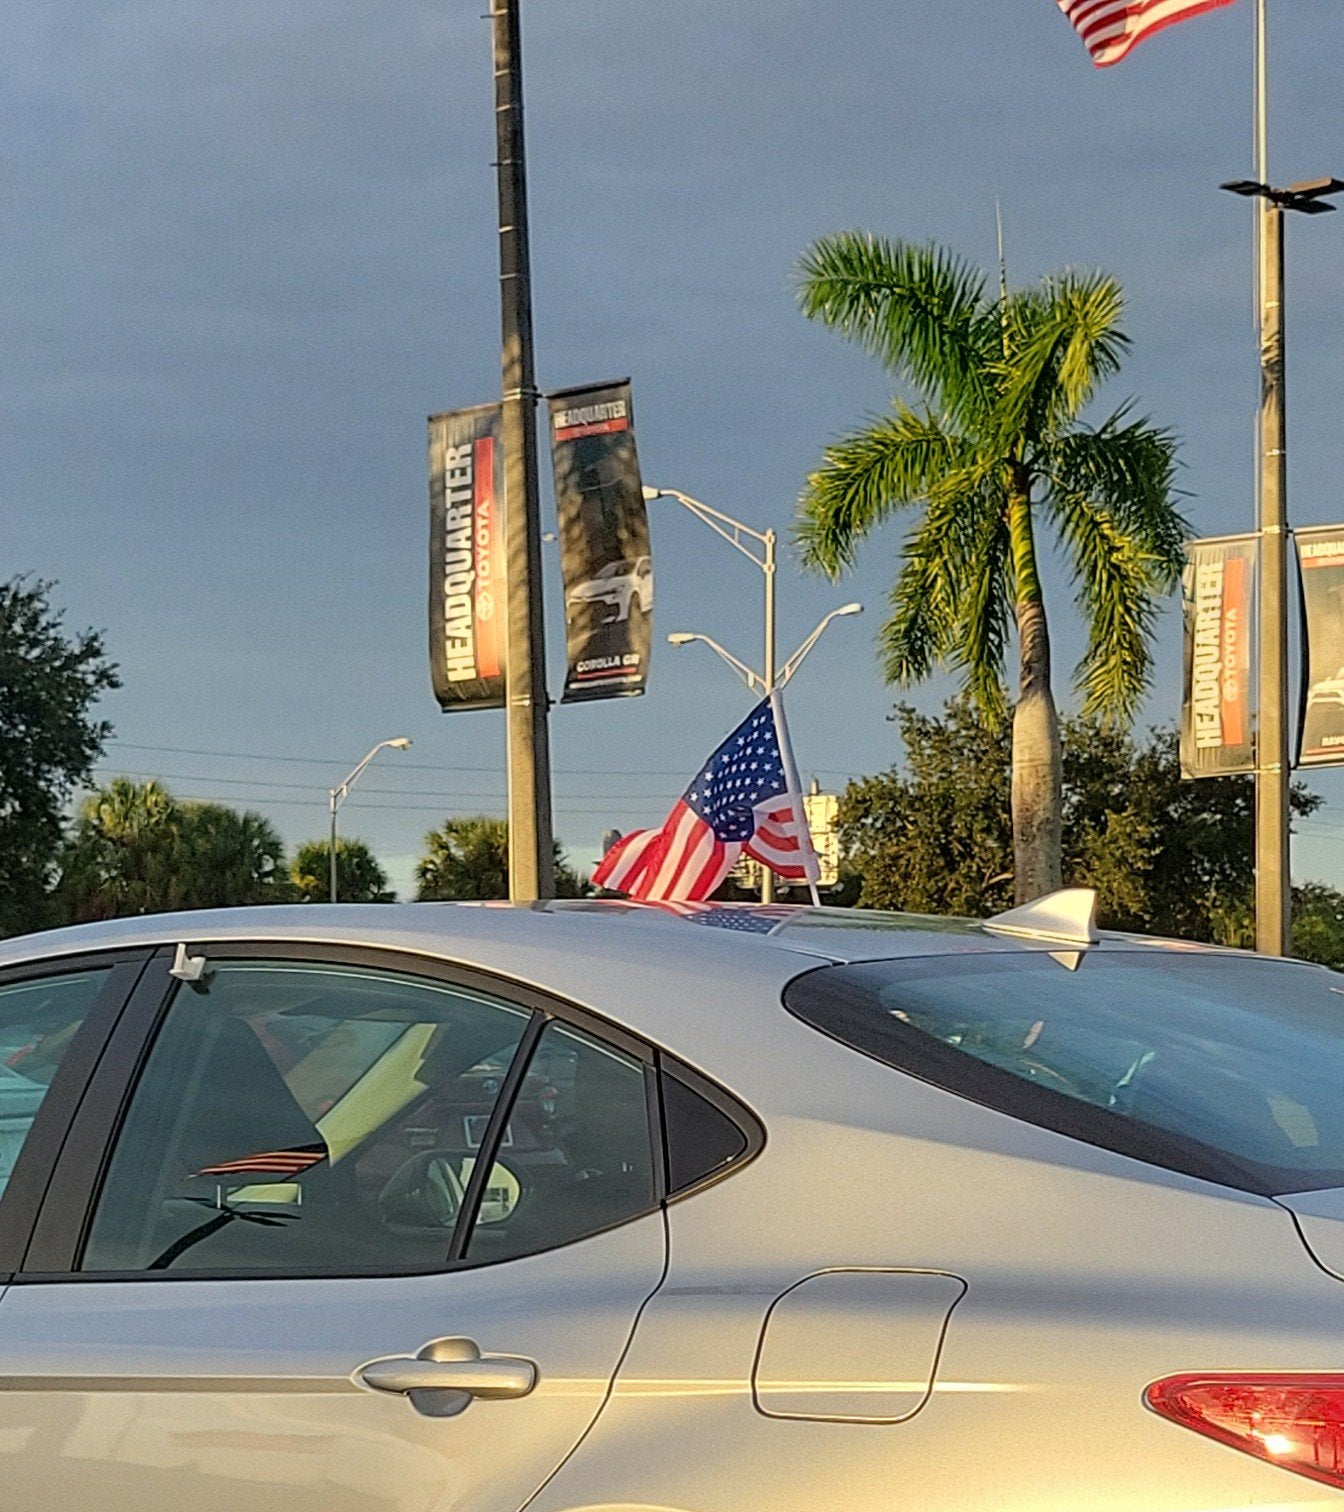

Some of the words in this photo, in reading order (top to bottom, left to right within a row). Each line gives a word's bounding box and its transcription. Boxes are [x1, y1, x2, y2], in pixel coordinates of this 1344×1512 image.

[444, 442, 477, 682] HEADQUARTER
[476, 501, 492, 588] TOYOTA
[1194, 561, 1224, 748] HEADQUARTER
[1224, 608, 1238, 685] TOYOTA
